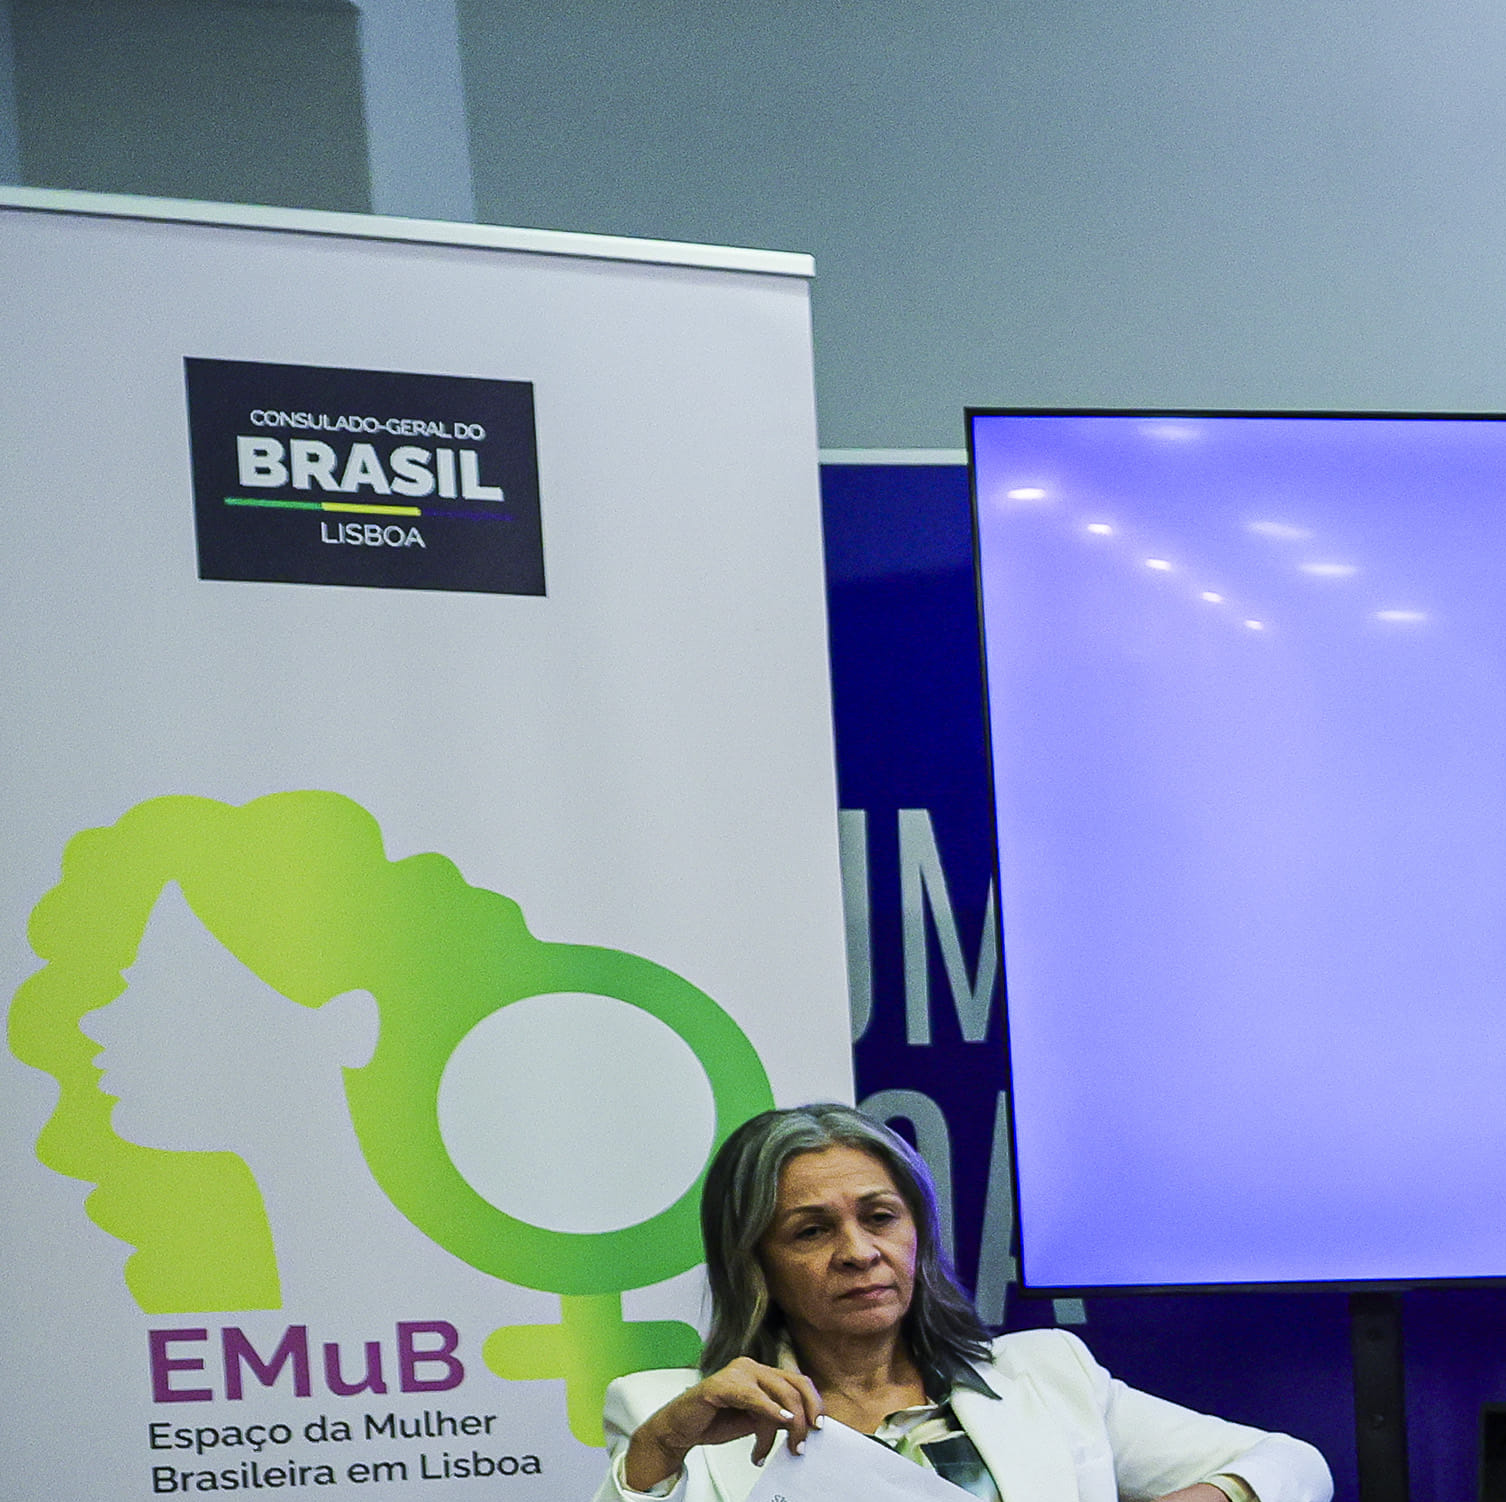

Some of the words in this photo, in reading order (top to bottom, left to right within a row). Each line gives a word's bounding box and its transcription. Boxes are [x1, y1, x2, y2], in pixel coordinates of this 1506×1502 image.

[250, 409, 452, 438] CONSULADO-GERAL
[454, 422, 486, 441] DO
[236, 435, 504, 501] BRASIL
[320, 521, 426, 548] LISBOA
[148, 1320, 464, 1403] EMuB
[148, 1422, 292, 1455] Espaço
[304, 1415, 351, 1443] da
[364, 1410, 498, 1440] Mulher
[151, 1460, 337, 1493] Brasileira
[347, 1461, 407, 1484] em
[420, 1452, 542, 1480] Lisboa
